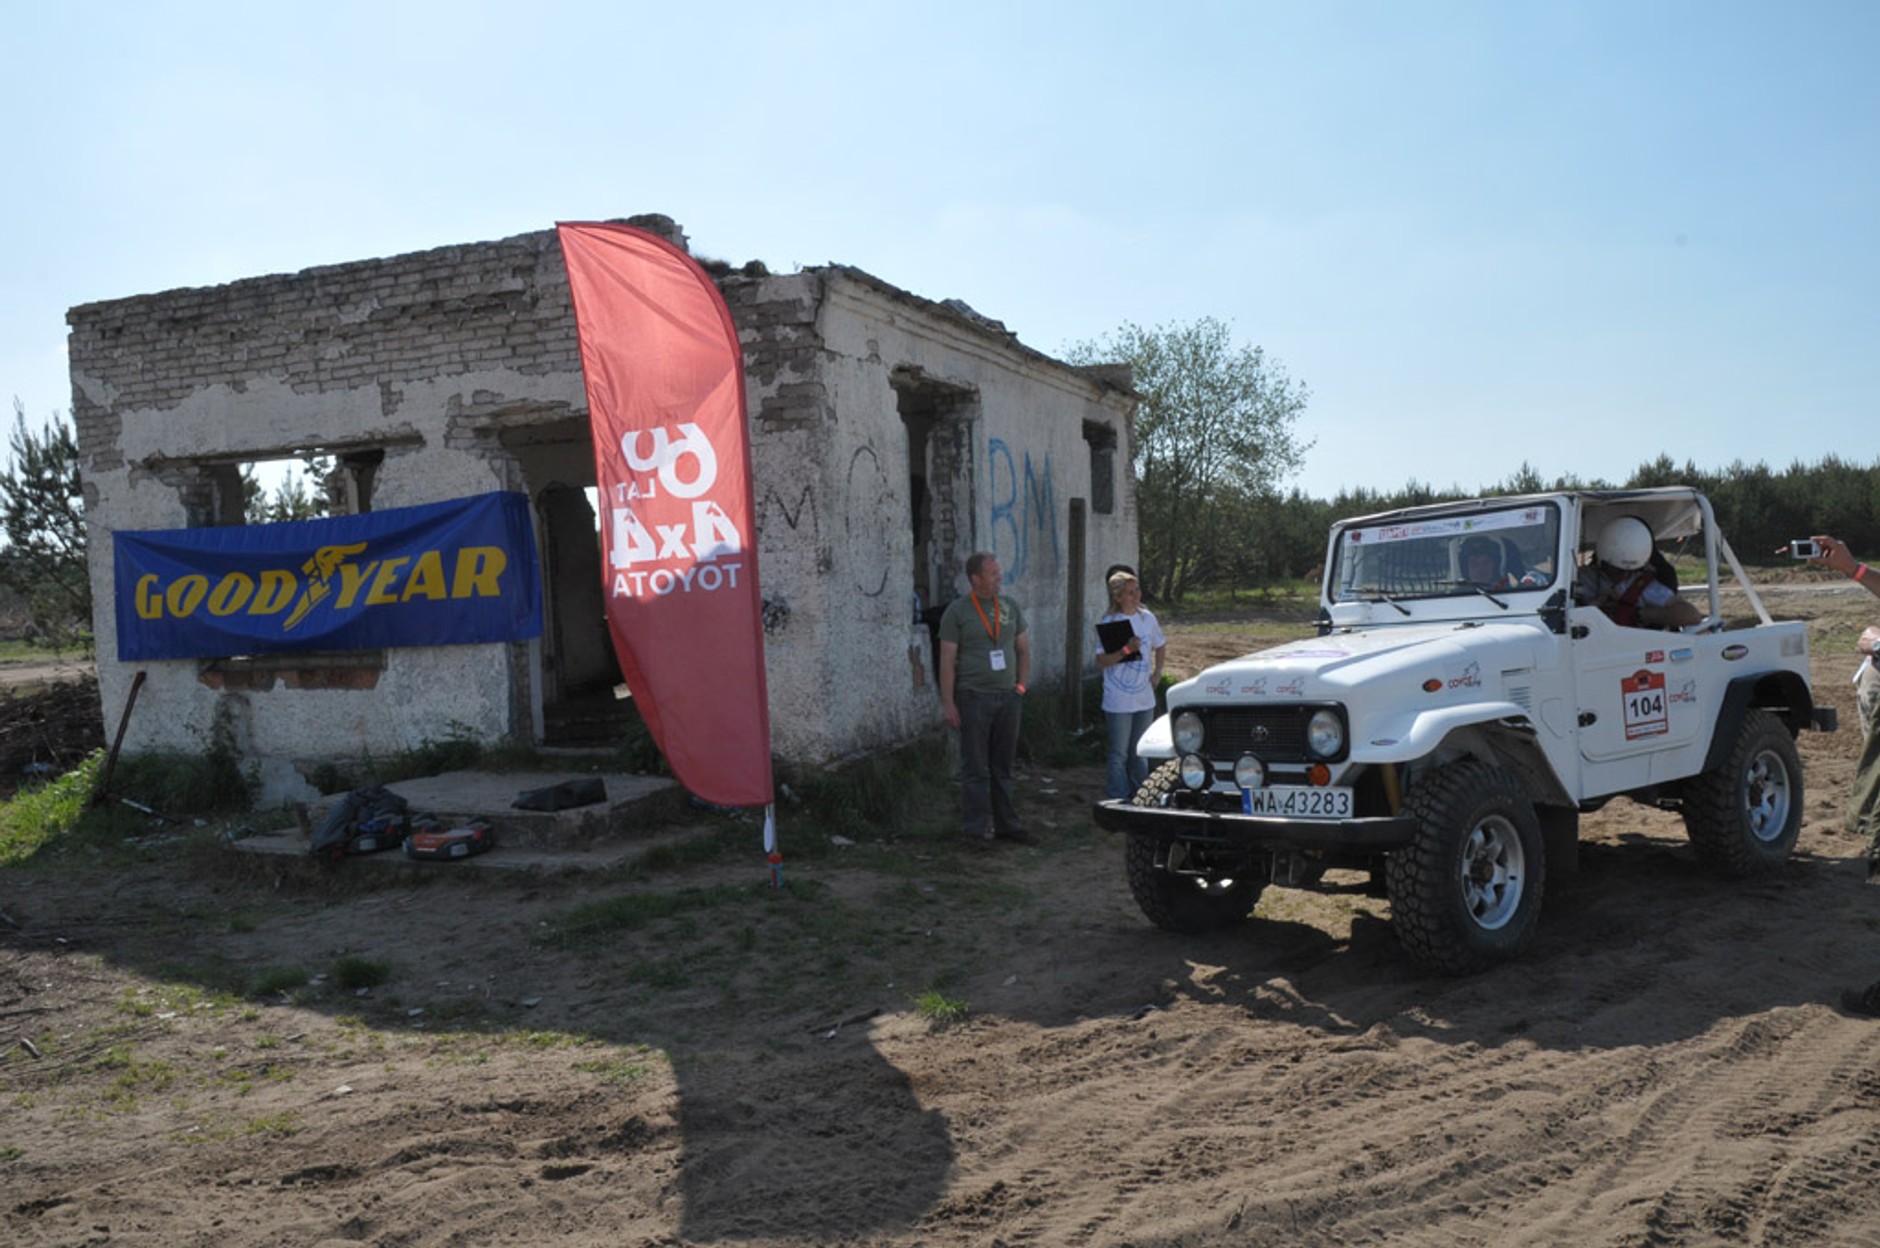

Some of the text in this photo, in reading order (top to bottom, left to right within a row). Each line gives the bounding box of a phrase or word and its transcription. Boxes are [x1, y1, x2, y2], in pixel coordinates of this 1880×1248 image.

[1630, 694, 1663, 718] 104
[1252, 790, 1349, 815] WA 43283
